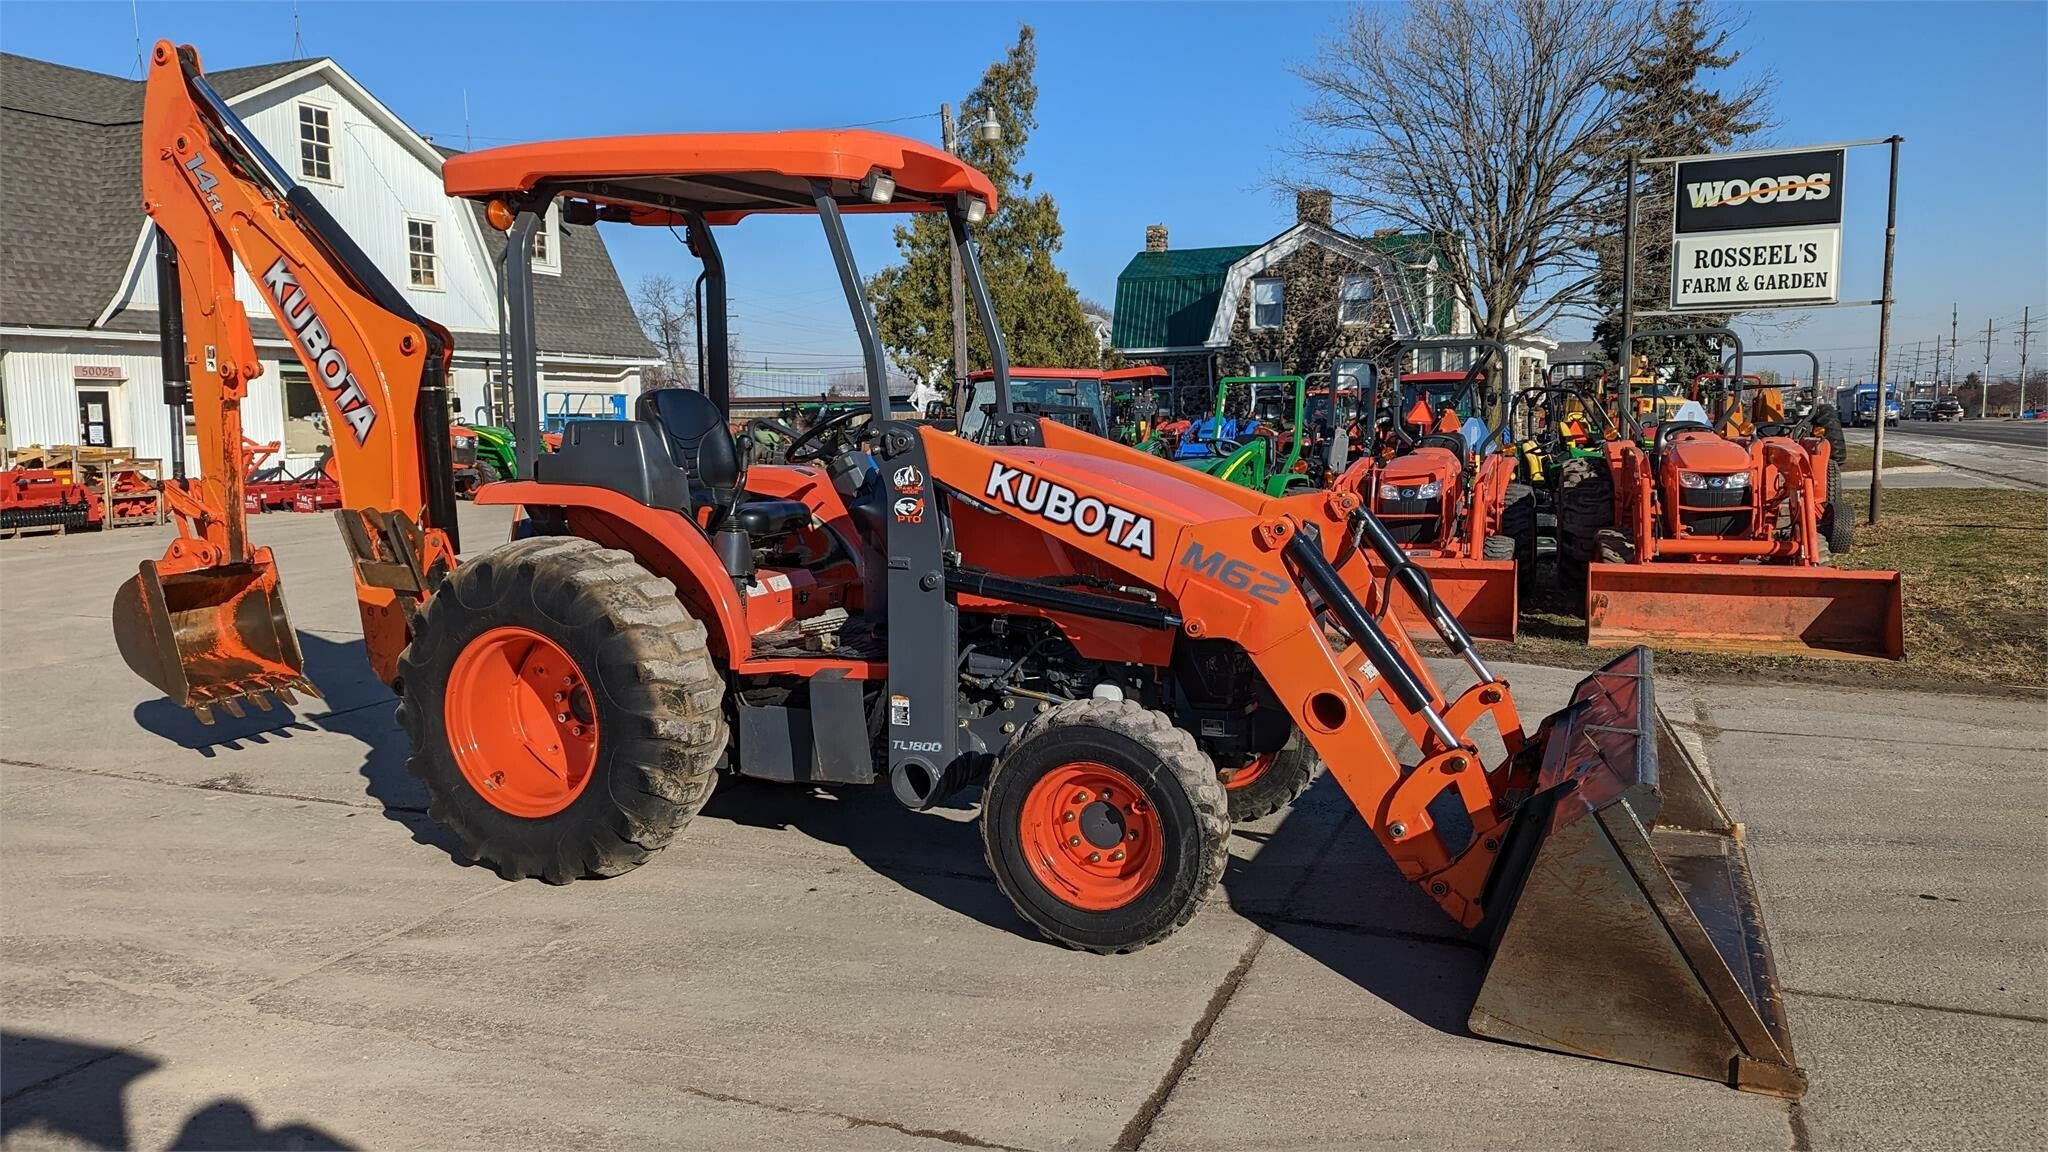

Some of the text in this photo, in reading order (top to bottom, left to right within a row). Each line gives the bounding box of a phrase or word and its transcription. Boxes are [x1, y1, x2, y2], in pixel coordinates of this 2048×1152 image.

[1686, 173, 1831, 209] WOODS
[1694, 242, 1818, 269] ROSSEEL'S
[1681, 271, 1829, 294] FARM & GARDEN
[262, 256, 376, 447] KUBOTA
[82, 367, 114, 377] 50025
[897, 515, 922, 524] PTO
[986, 463, 1155, 557] KUBOTA
[1180, 541, 1290, 605] M62
[893, 740, 942, 752] TL1800
